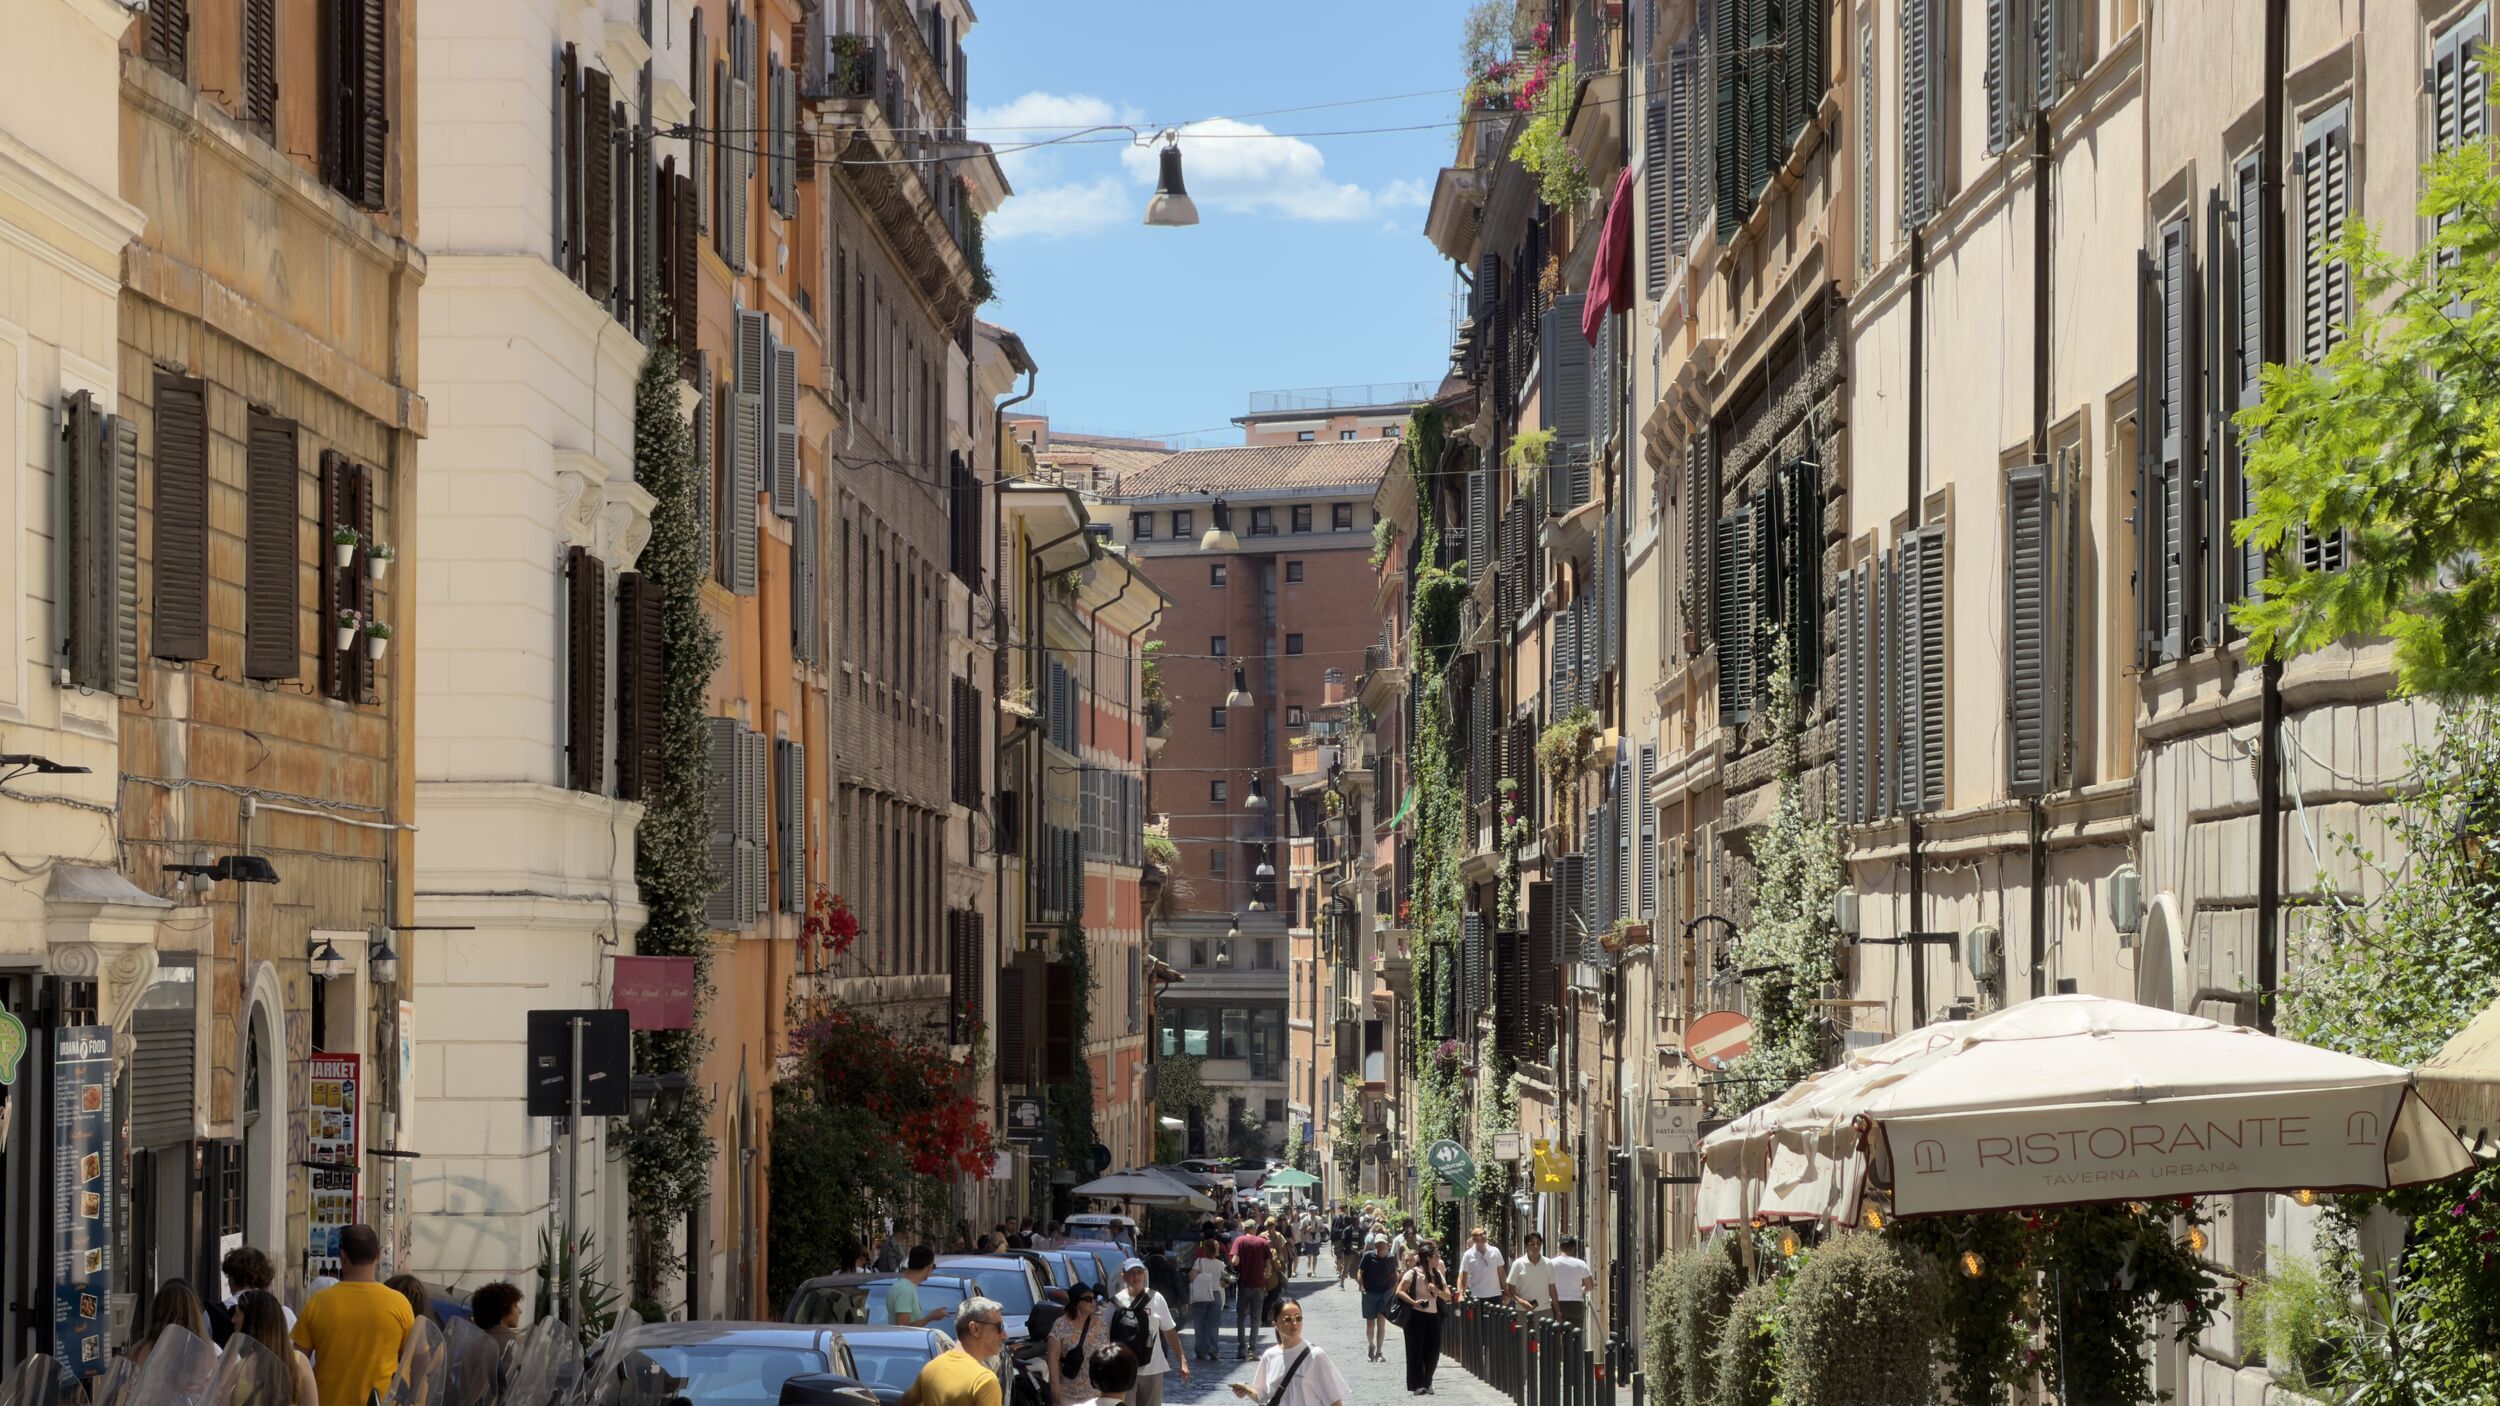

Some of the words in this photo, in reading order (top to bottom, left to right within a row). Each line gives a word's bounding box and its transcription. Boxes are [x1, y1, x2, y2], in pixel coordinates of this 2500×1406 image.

[60, 1041, 79, 1056] URBANA
[88, 1039, 106, 1054] FOOD
[1977, 1116, 2311, 1168] RISTORANTE
[2042, 1168, 2140, 1186] TAVERNA
[2151, 1161, 2240, 1178] URBANA
